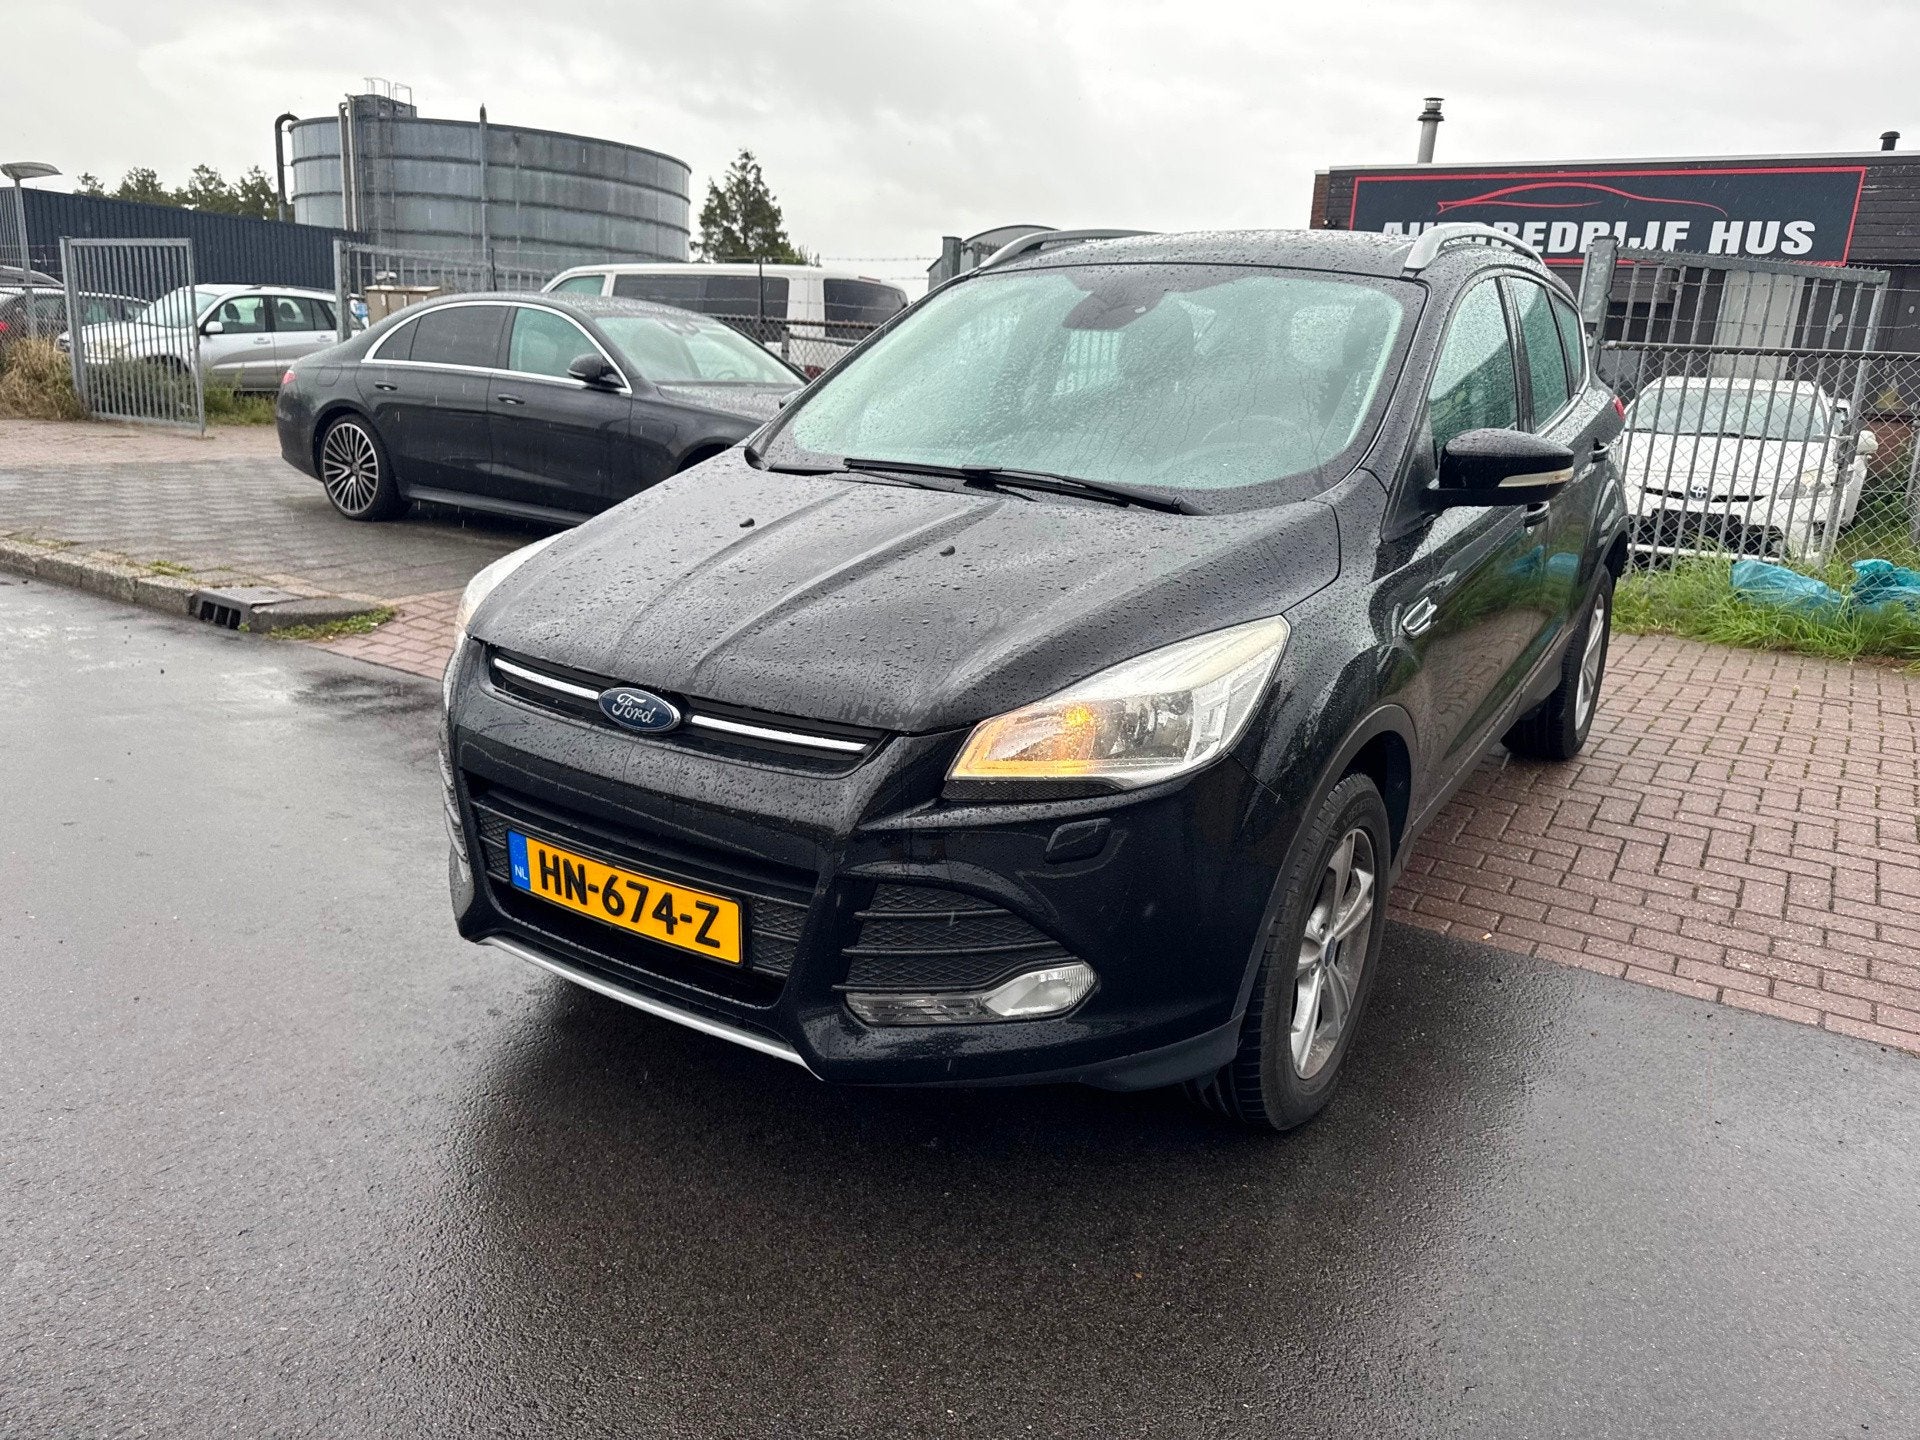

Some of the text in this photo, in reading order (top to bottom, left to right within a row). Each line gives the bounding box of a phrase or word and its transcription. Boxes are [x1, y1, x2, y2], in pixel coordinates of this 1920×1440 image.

[1382, 220, 1816, 255] BEDRIJF HUS
[612, 693, 656, 723] Ford
[514, 849, 721, 949] NL HN-674-Z
